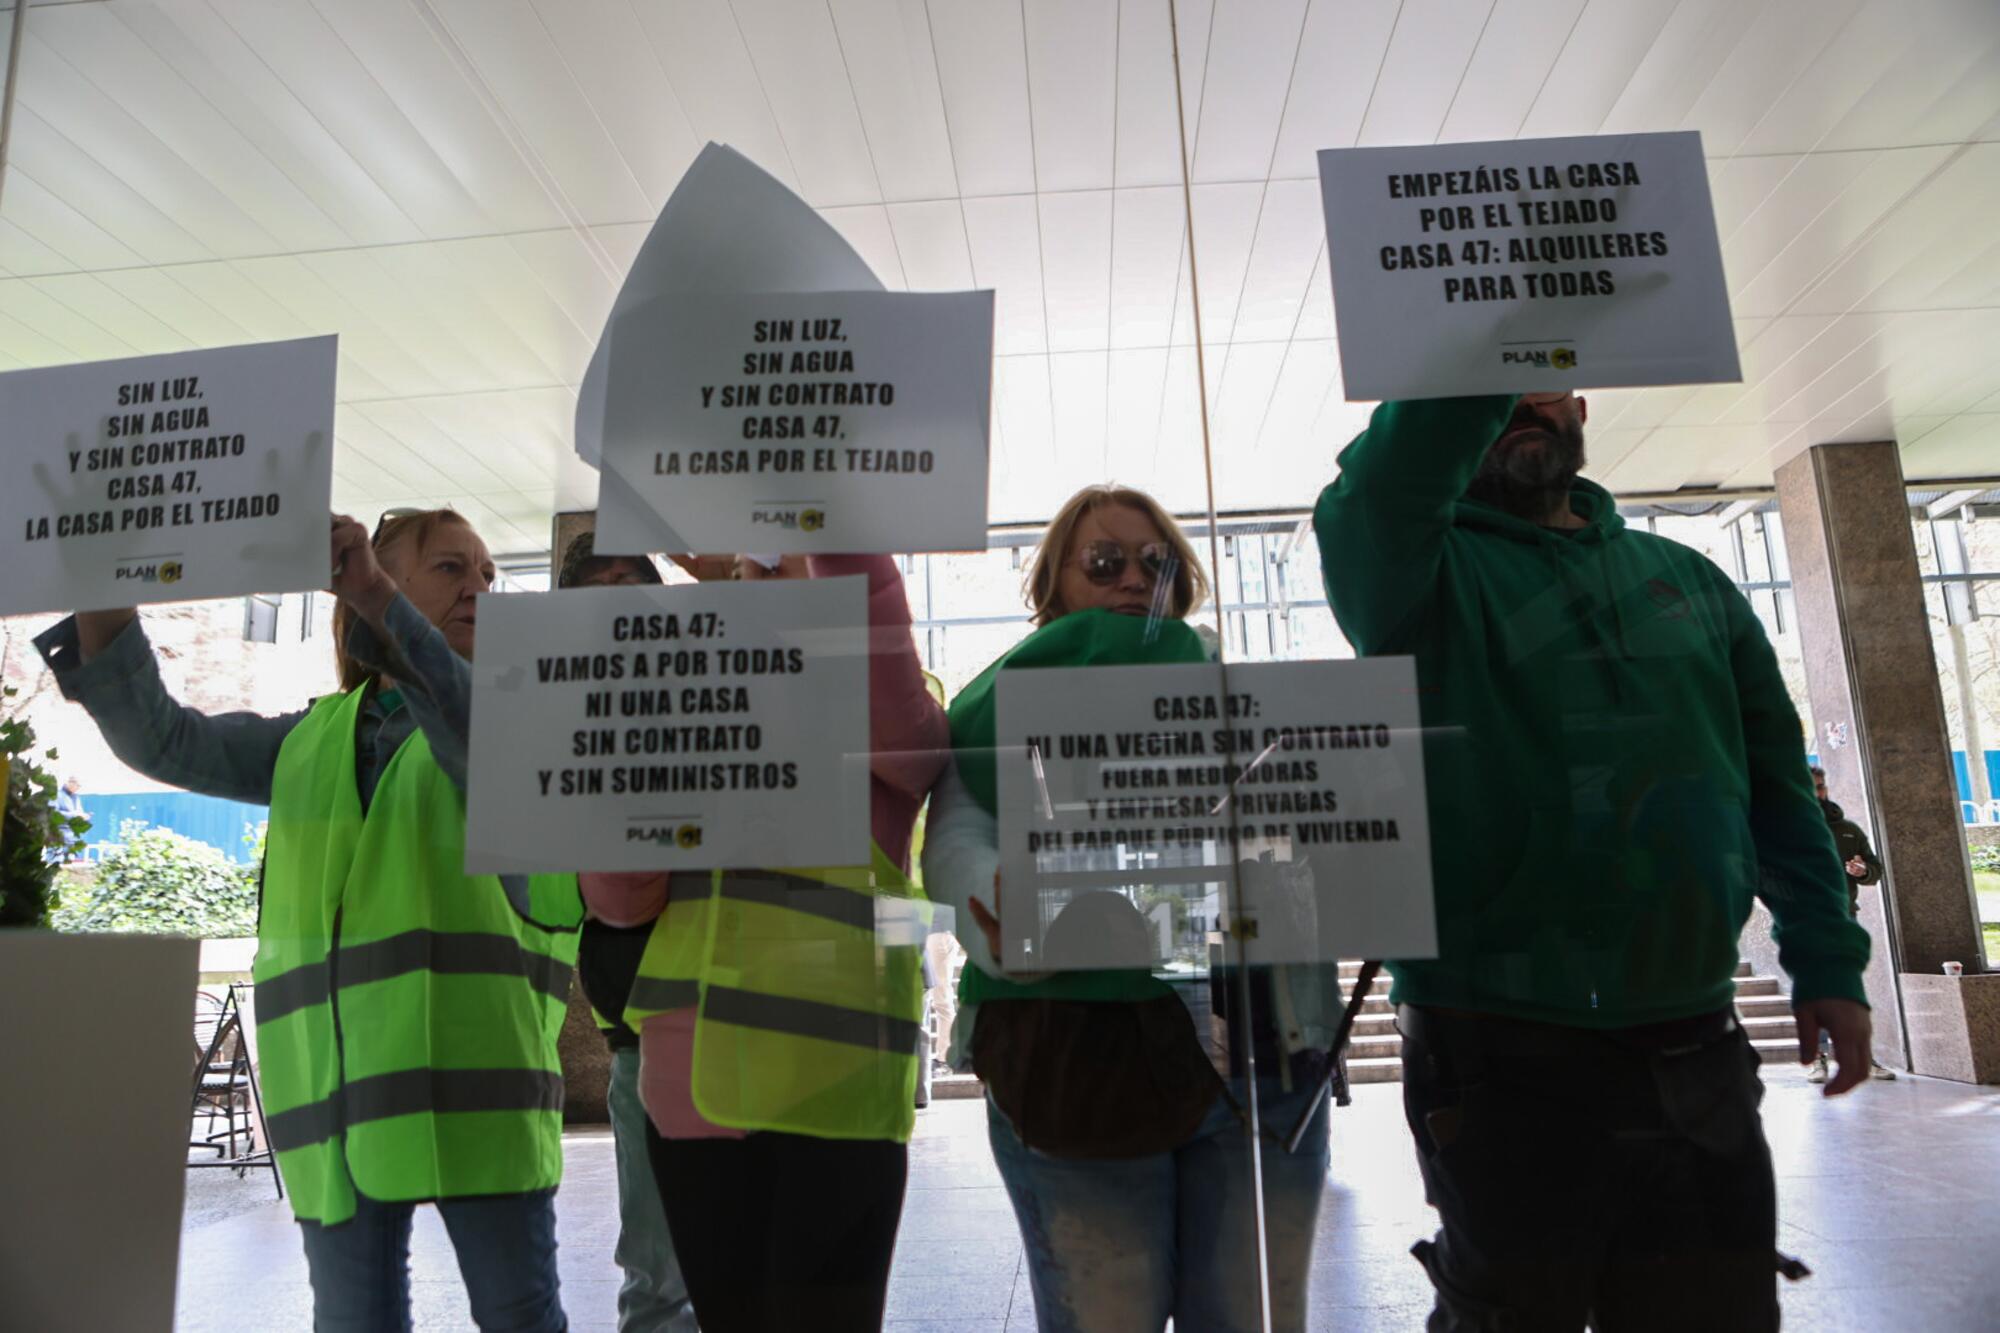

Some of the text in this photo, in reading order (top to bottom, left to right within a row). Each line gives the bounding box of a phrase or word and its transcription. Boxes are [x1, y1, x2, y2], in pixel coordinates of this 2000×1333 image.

[1388, 162, 1640, 199] EMPEZÁIS LA CASA
[1420, 198, 1617, 233] POR EL TEJADO
[1380, 232, 1668, 271] CASA 47: ALQUILERES
[1444, 271, 1615, 302] PARA TODAS
[754, 319, 848, 342] SIN LUZ,
[743, 351, 854, 374] SIN AGUA
[118, 377, 204, 406] SIN LUZ,
[701, 383, 894, 408] Y SIN CONTRATO
[108, 407, 209, 438] SIN AGUA
[742, 416, 846, 439] CASA 47,
[69, 434, 245, 473] Y SIN CONTRATO
[654, 449, 934, 475] LA CASA POR EL TEJADO
[108, 471, 202, 500] CASA 47,
[26, 494, 280, 541] LA CASA POR EL TEJADO
[613, 613, 725, 642] CASA 47:
[537, 648, 804, 683] VAMOS A POR TODAS
[586, 688, 749, 717] NI UNA CASA
[1154, 694, 1261, 721] CASA 47:
[573, 725, 761, 756] SIN CONTRATO
[1027, 725, 1391, 758] NI UNA VECINA SIN CONTRATO
[538, 763, 798, 796] Y SIN SUMINISTROS
[1103, 768, 1169, 789] FUERA
[1086, 800, 1099, 820] Y
[1107, 796, 1221, 819] EMPRESAS
[1297, 819, 1400, 844] VIVIENDA
